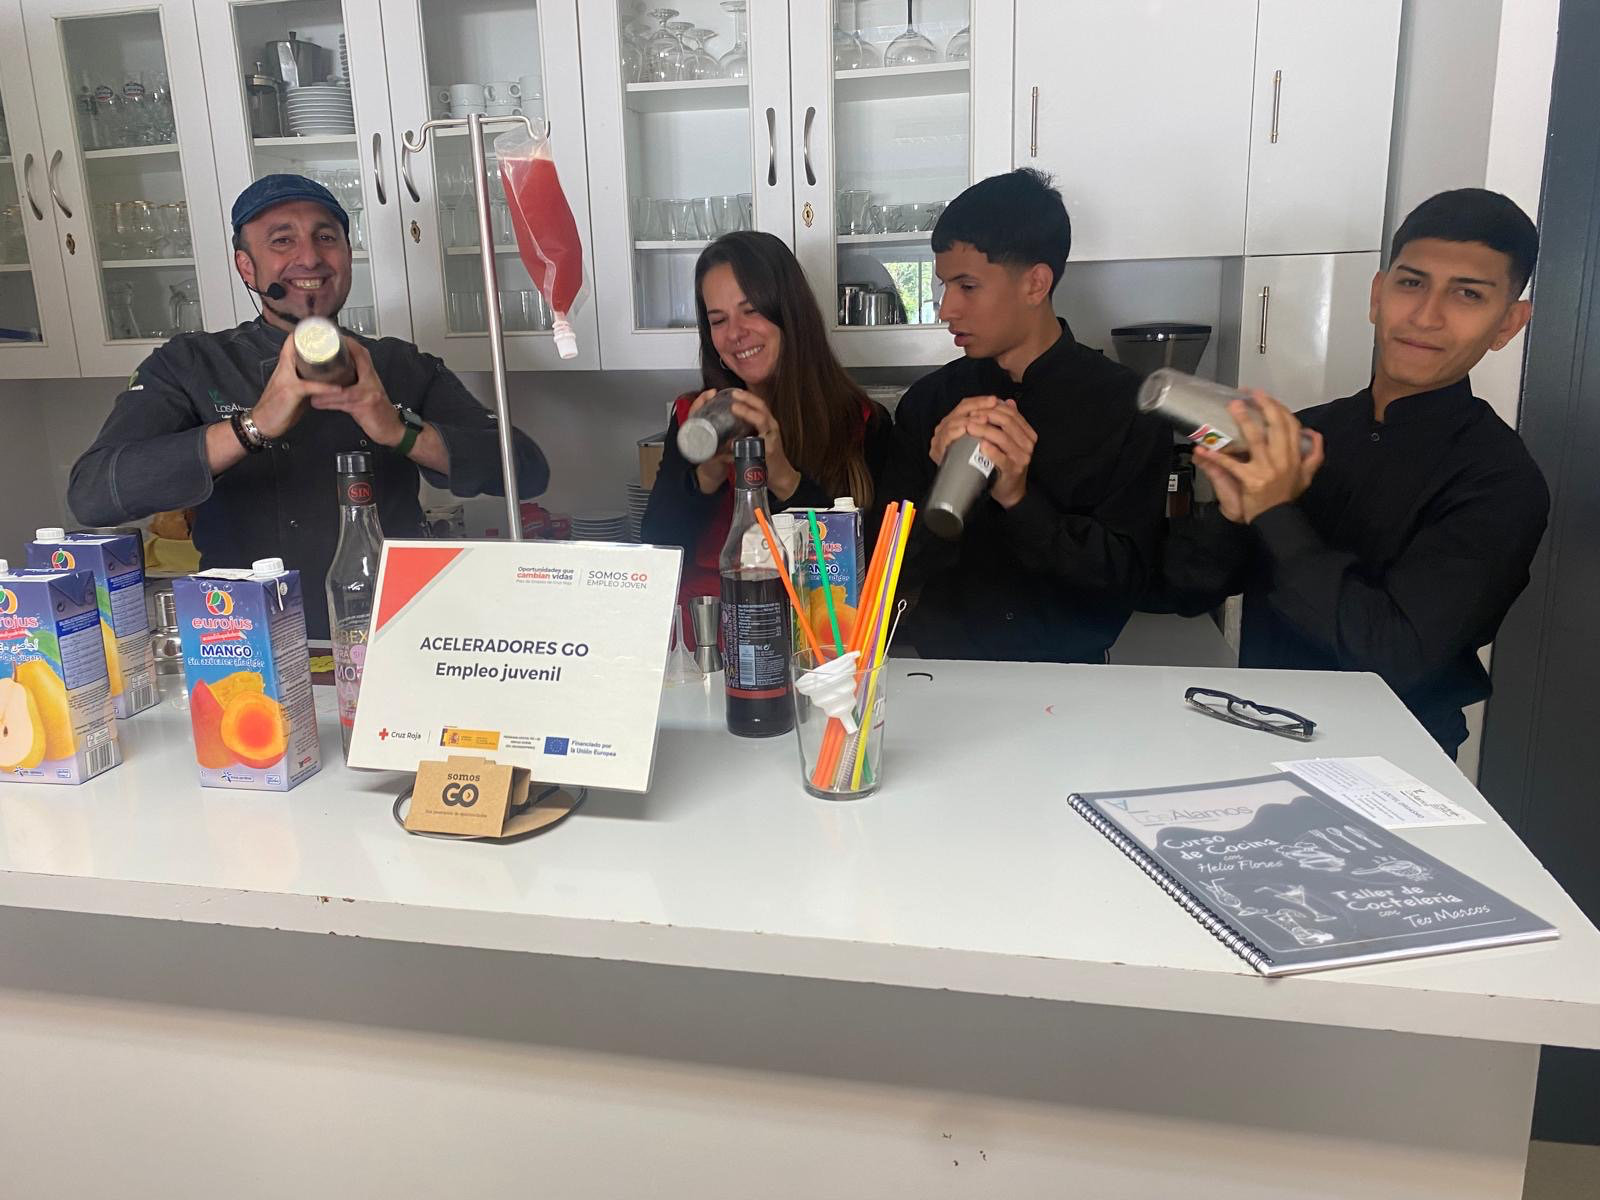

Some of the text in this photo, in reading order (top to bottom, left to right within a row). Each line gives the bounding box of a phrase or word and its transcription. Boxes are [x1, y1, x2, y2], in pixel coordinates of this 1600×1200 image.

[746, 472, 764, 481] SIN
[350, 487, 370, 497] SIN
[517, 566, 562, 574] Oportunidades
[551, 573, 573, 581] vidas
[588, 570, 648, 582] SOMOS GO
[587, 579, 647, 589] EMPLEO JOVEN
[192, 615, 253, 631] eurojus
[200, 644, 252, 658] MANGO
[420, 636, 589, 657] ACELERADORES GO
[436, 662, 562, 682] Empleo juvenil
[390, 731, 422, 740] Cruz Roja
[571, 740, 601, 748] Financiado
[447, 773, 481, 782] somos
[442, 782, 480, 808] GO
[1162, 834, 1226, 849] Curso
[1179, 837, 1280, 860] de Cocina
[1198, 859, 1284, 873] Helio Flores
[1330, 885, 1425, 901] Taller de
[1402, 904, 1491, 928] Teo Marcos
